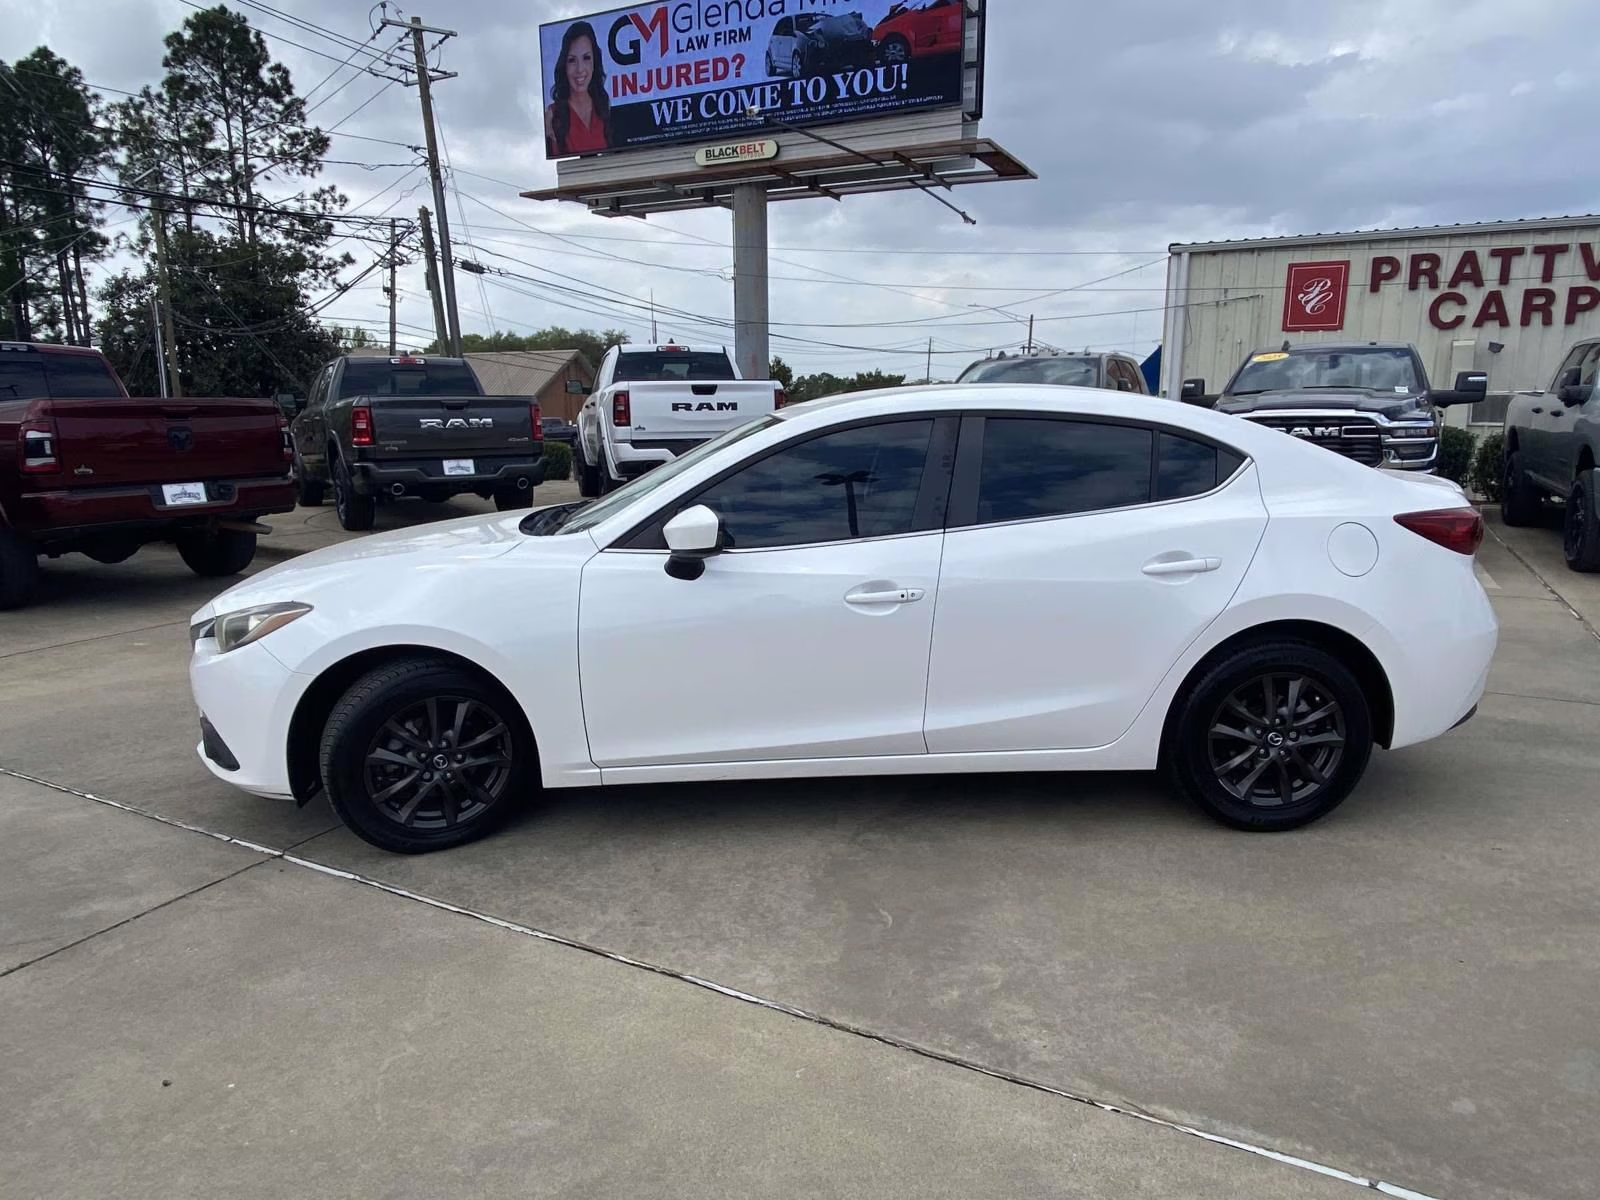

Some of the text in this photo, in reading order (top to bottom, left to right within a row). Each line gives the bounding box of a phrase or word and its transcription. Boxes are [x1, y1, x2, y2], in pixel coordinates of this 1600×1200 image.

[672, 0, 785, 33] Glenda
[676, 26, 751, 54] LAW FIRM
[612, 53, 746, 98] INJURED?
[651, 97, 693, 126] WE
[700, 83, 782, 118] COME
[787, 76, 827, 106] TO
[831, 63, 908, 101] YOU!
[1428, 286, 1600, 330] CARP
[419, 418, 494, 429] RAM
[671, 402, 738, 412] RAM
